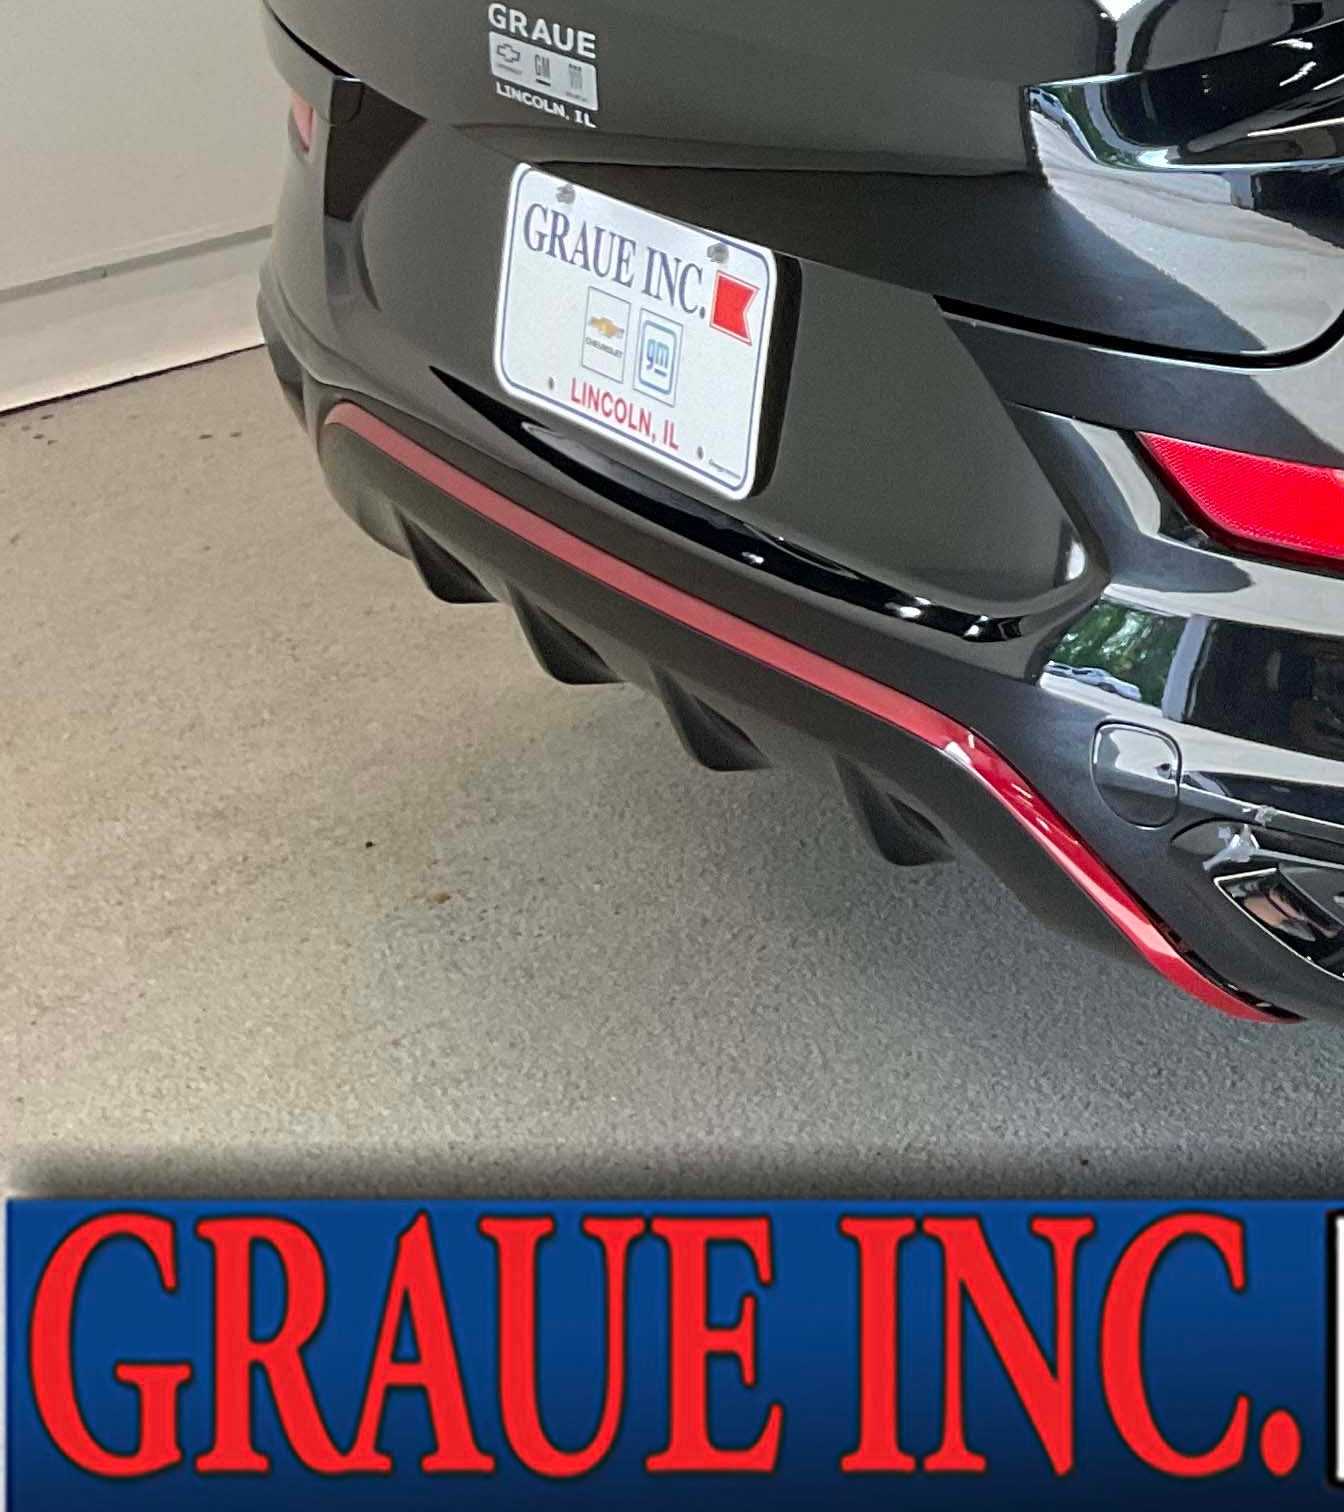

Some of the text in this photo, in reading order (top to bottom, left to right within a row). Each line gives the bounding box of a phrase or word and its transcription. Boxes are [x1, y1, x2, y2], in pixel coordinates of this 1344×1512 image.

[488, 2, 597, 59] GRAUE
[574, 109, 597, 129] IL
[522, 203, 706, 320] GRAUE INC.
[570, 377, 680, 450] LINCOLN, IL
